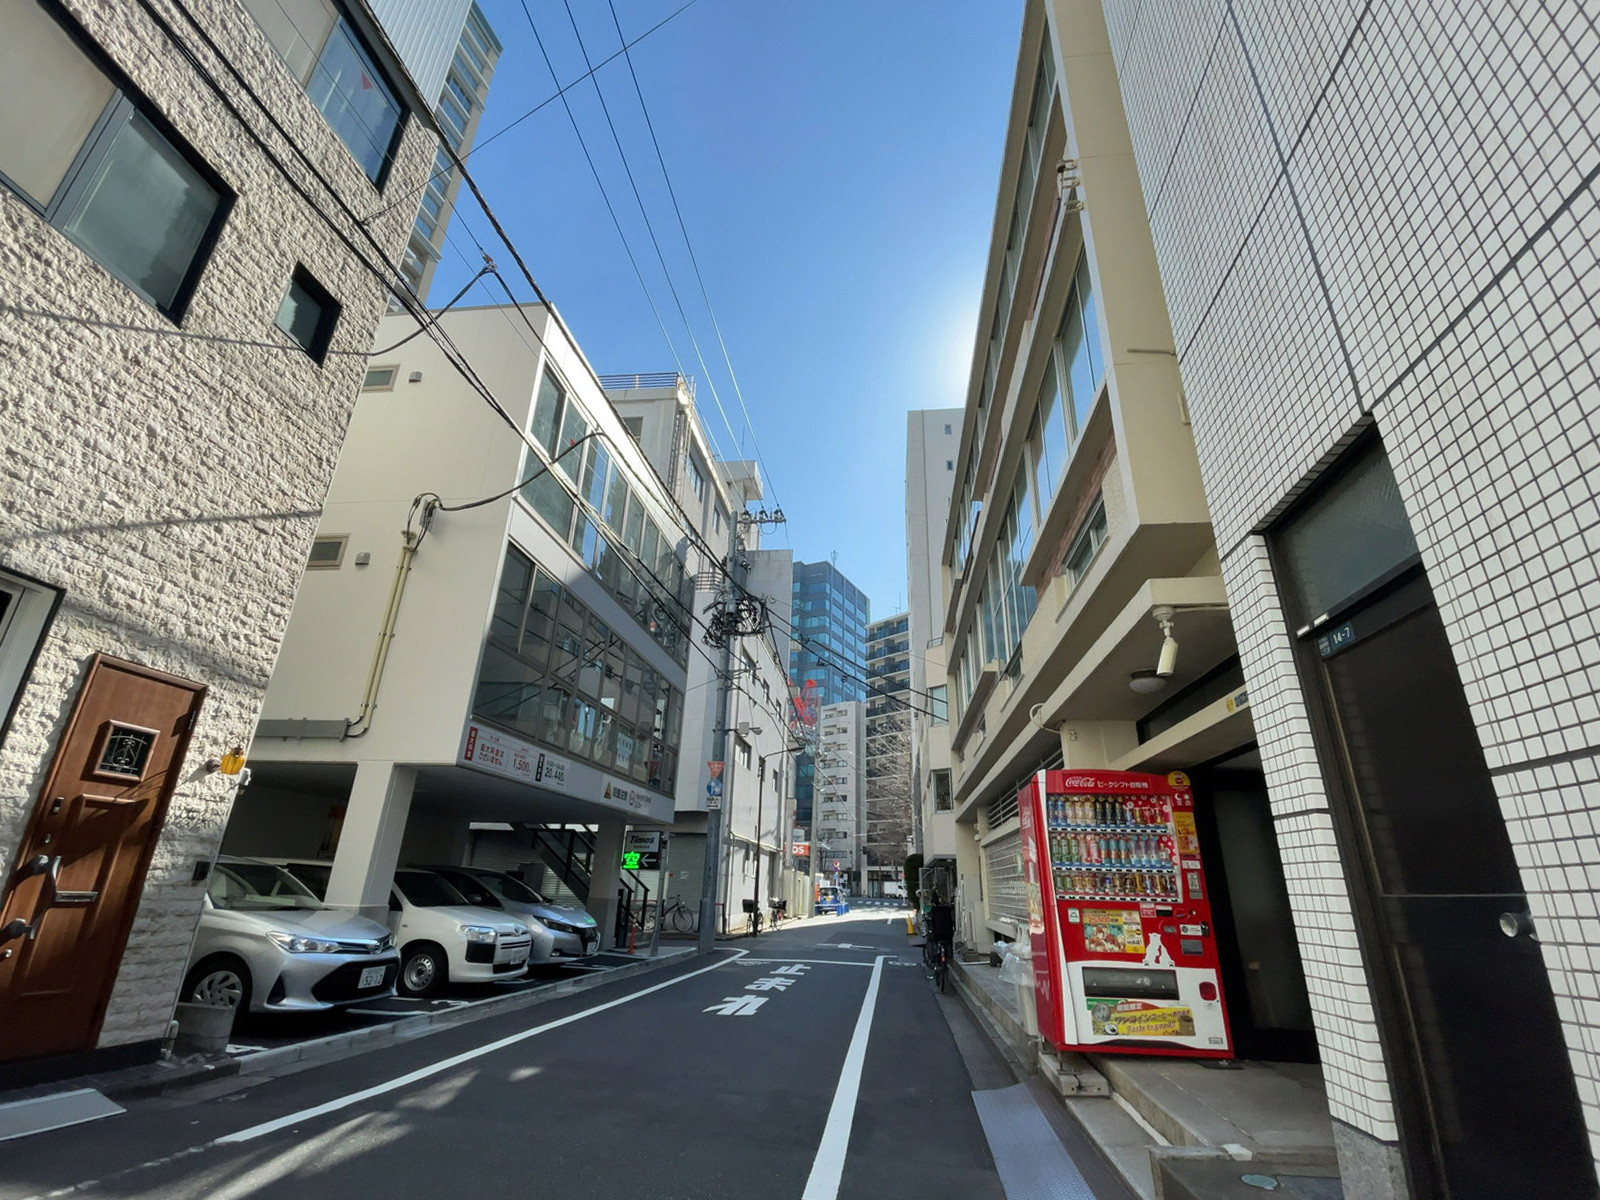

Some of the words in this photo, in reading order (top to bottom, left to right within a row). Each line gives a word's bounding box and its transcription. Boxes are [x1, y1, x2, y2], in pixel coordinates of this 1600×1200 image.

[1332, 626, 1350, 643] 14-7
[630, 836, 655, 844] Times
[623, 851, 640, 869] 空
[701, 964, 811, 1016] 止まれ
